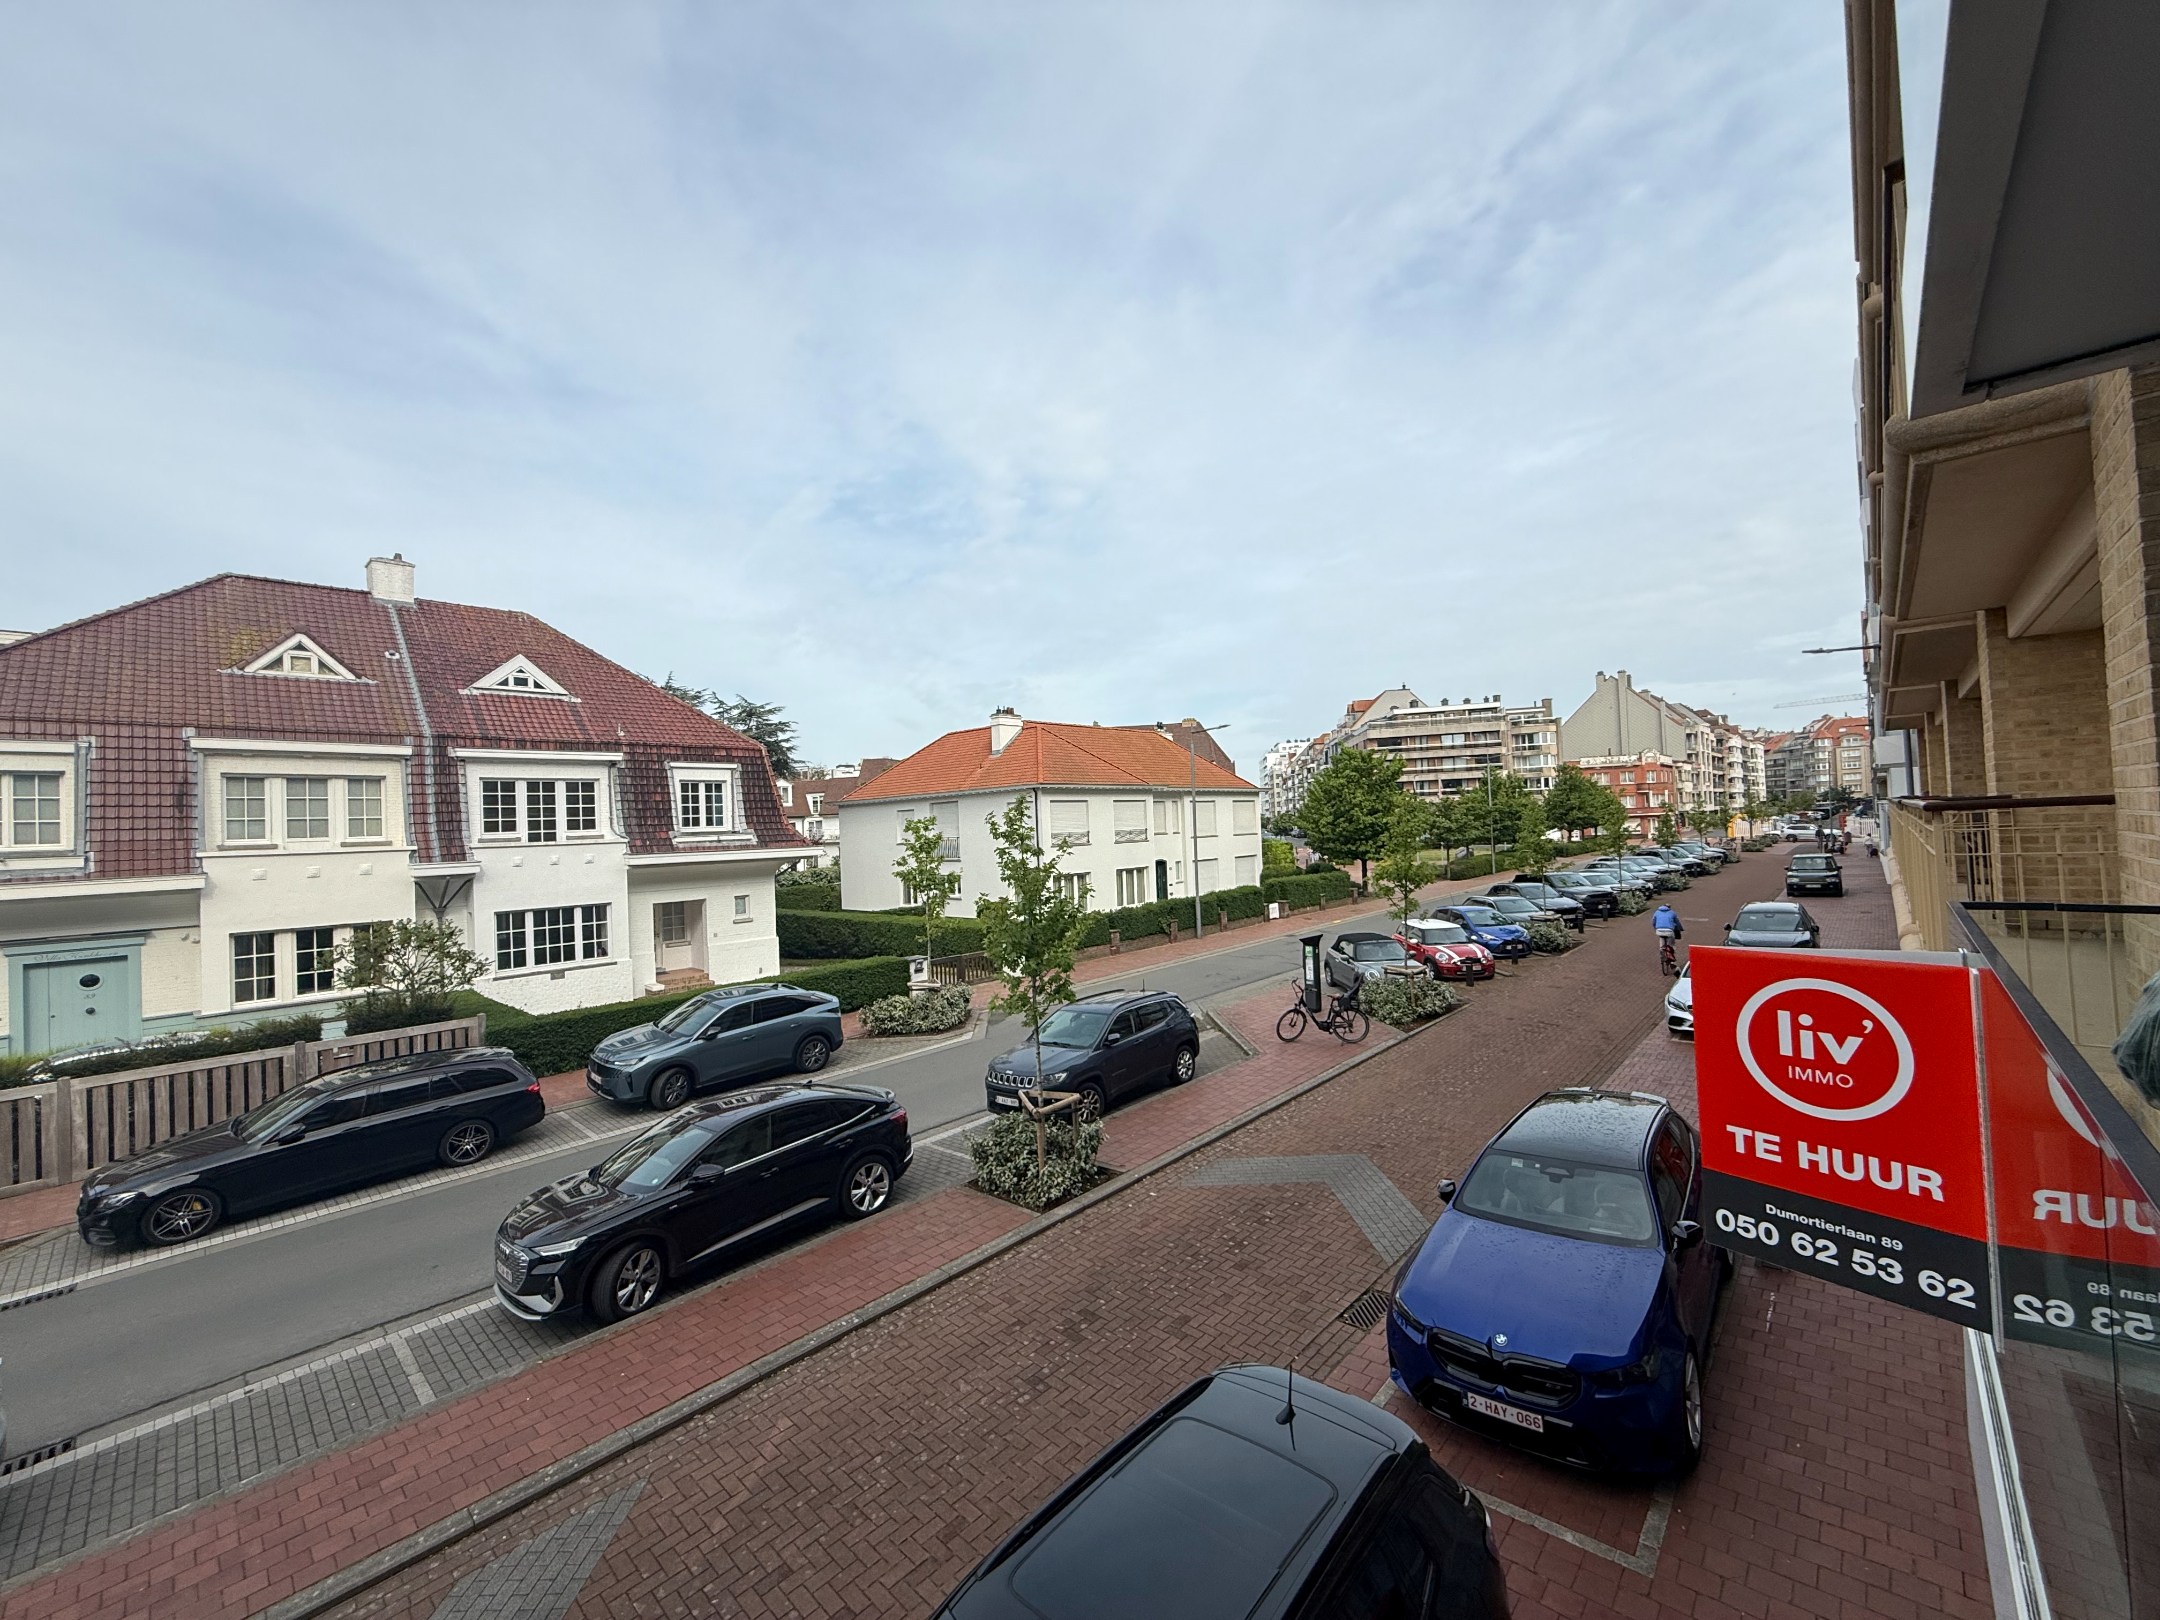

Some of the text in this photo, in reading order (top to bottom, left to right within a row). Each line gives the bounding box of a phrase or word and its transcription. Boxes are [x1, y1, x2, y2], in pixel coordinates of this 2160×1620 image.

[1788, 1065, 1854, 1088] IMMO
[1726, 1124, 1944, 1202] TE HUUR
[1715, 1208, 1976, 1309] 050 62 53 62
[1765, 1203, 1904, 1251] Dumortierlaan 89
